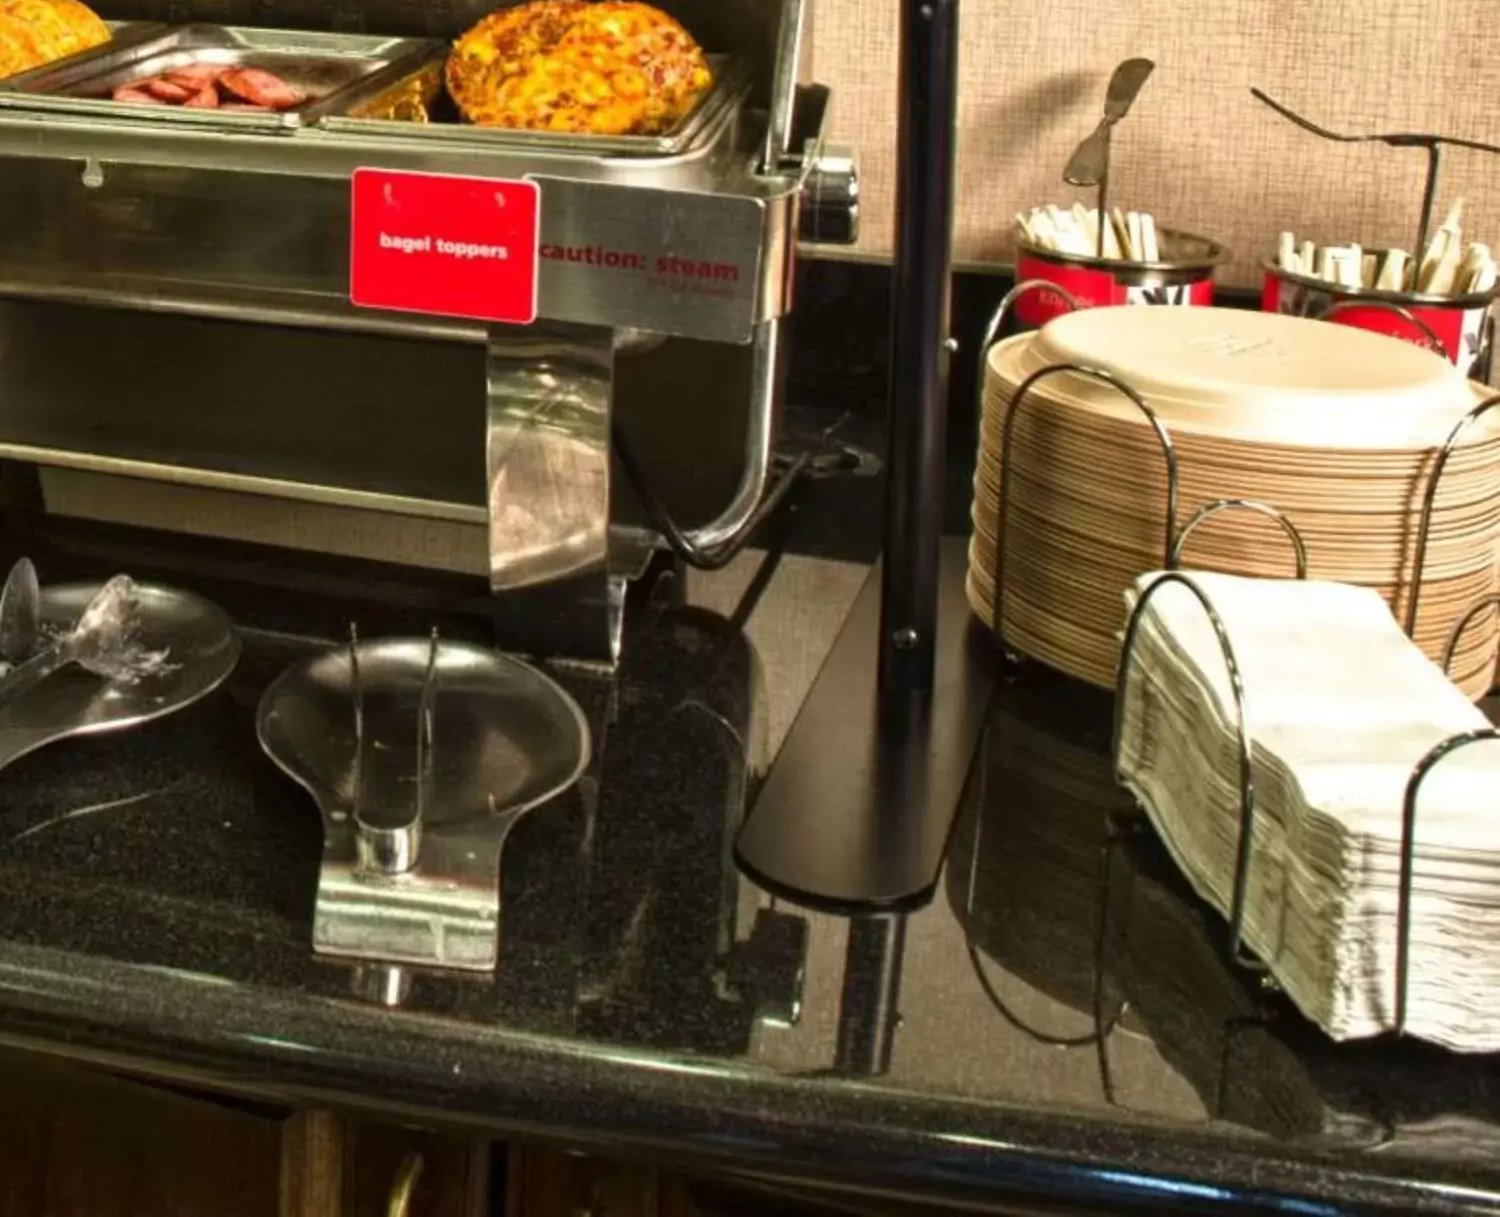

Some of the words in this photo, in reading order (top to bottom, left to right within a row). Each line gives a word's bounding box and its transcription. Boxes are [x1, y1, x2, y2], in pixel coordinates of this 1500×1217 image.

[379, 231, 432, 254] bagel
[436, 238, 509, 260] toppers
[539, 242, 646, 270] caution:
[655, 255, 740, 282] steam
